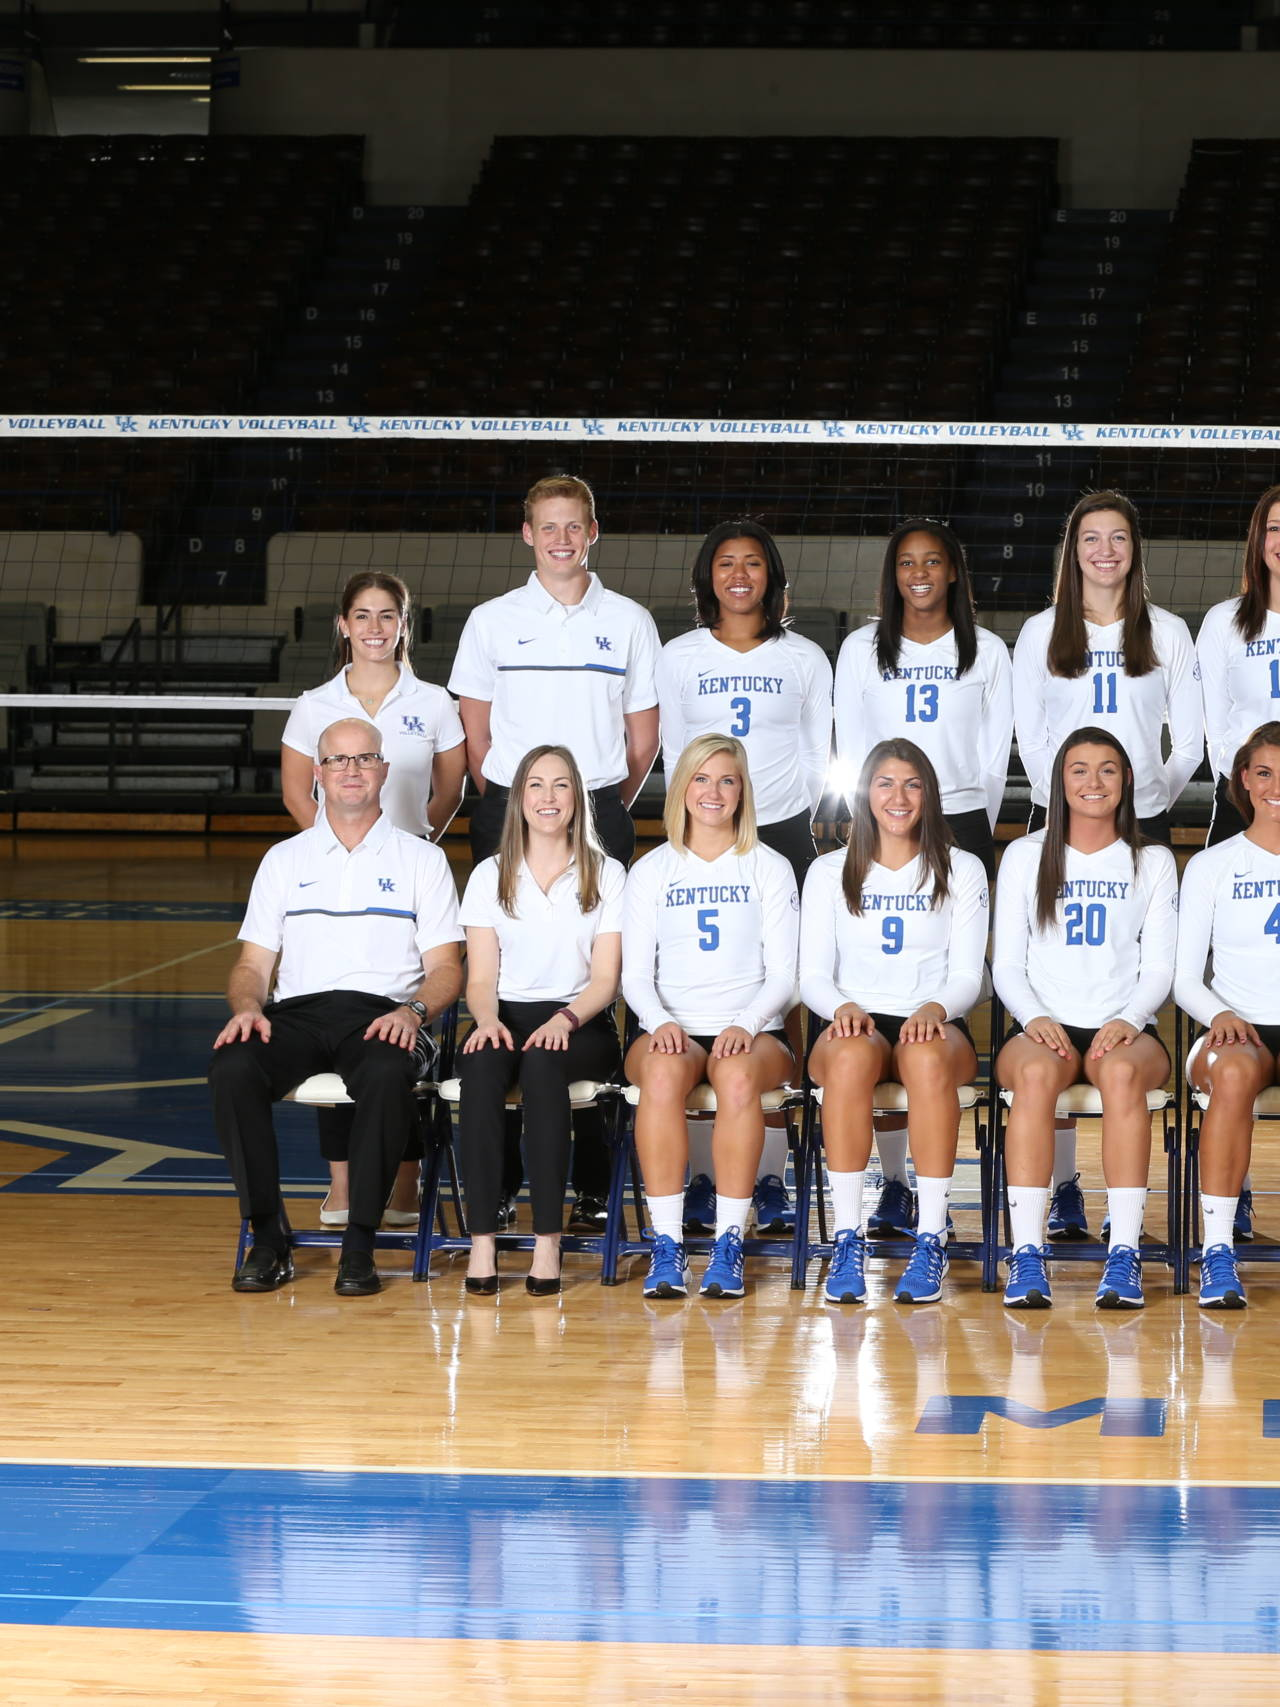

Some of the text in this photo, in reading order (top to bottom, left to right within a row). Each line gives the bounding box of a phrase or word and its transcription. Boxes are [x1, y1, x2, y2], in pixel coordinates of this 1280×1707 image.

[406, 207, 425, 220] 20
[1109, 211, 1126, 223] 20
[397, 232, 413, 245] 19
[1104, 236, 1120, 248] 19
[384, 258, 400, 271] 18
[1097, 262, 1113, 275] 18
[372, 282, 389, 296] 17
[1088, 288, 1106, 300] 17
[359, 309, 376, 322] 16
[1080, 313, 1097, 326] 16
[345, 335, 362, 349] 15
[1072, 340, 1088, 353] 15
[331, 363, 348, 375] 14
[1060, 366, 1080, 380] 14
[316, 389, 334, 403] 13
[1054, 394, 1072, 408] 13
[8, 418, 104, 429] VOLLEYBALL
[147, 418, 230, 429] KENTUCKY
[238, 418, 336, 430] VOLLEYBALL
[379, 419, 463, 430] KENTUCKY
[470, 420, 570, 431] VOLLEYBALL
[616, 421, 701, 432] KENTUCKY
[710, 422, 810, 433] VOLLEYBALL
[854, 424, 941, 435] KENTUCKY
[947, 425, 1050, 437] VOLLEYBALL
[1095, 427, 1182, 438] KENTUCKY
[286, 447, 302, 461] 11
[1036, 453, 1051, 467] 11
[1025, 482, 1045, 497] 10
[252, 507, 262, 521] 9
[1012, 513, 1024, 528] 9
[235, 539, 245, 553] 8
[1003, 544, 1013, 559] 8
[216, 571, 227, 585] 7
[992, 577, 1002, 592] 7
[698, 676, 783, 696] KENTUCKY
[1093, 672, 1117, 713] 11
[905, 684, 939, 722] 13
[730, 697, 752, 737] 3
[666, 886, 751, 907] KENTUCKY
[862, 894, 935, 911] ENTUCKY
[697, 909, 720, 952] 5
[1064, 903, 1107, 946] 20
[882, 916, 904, 955] 9
